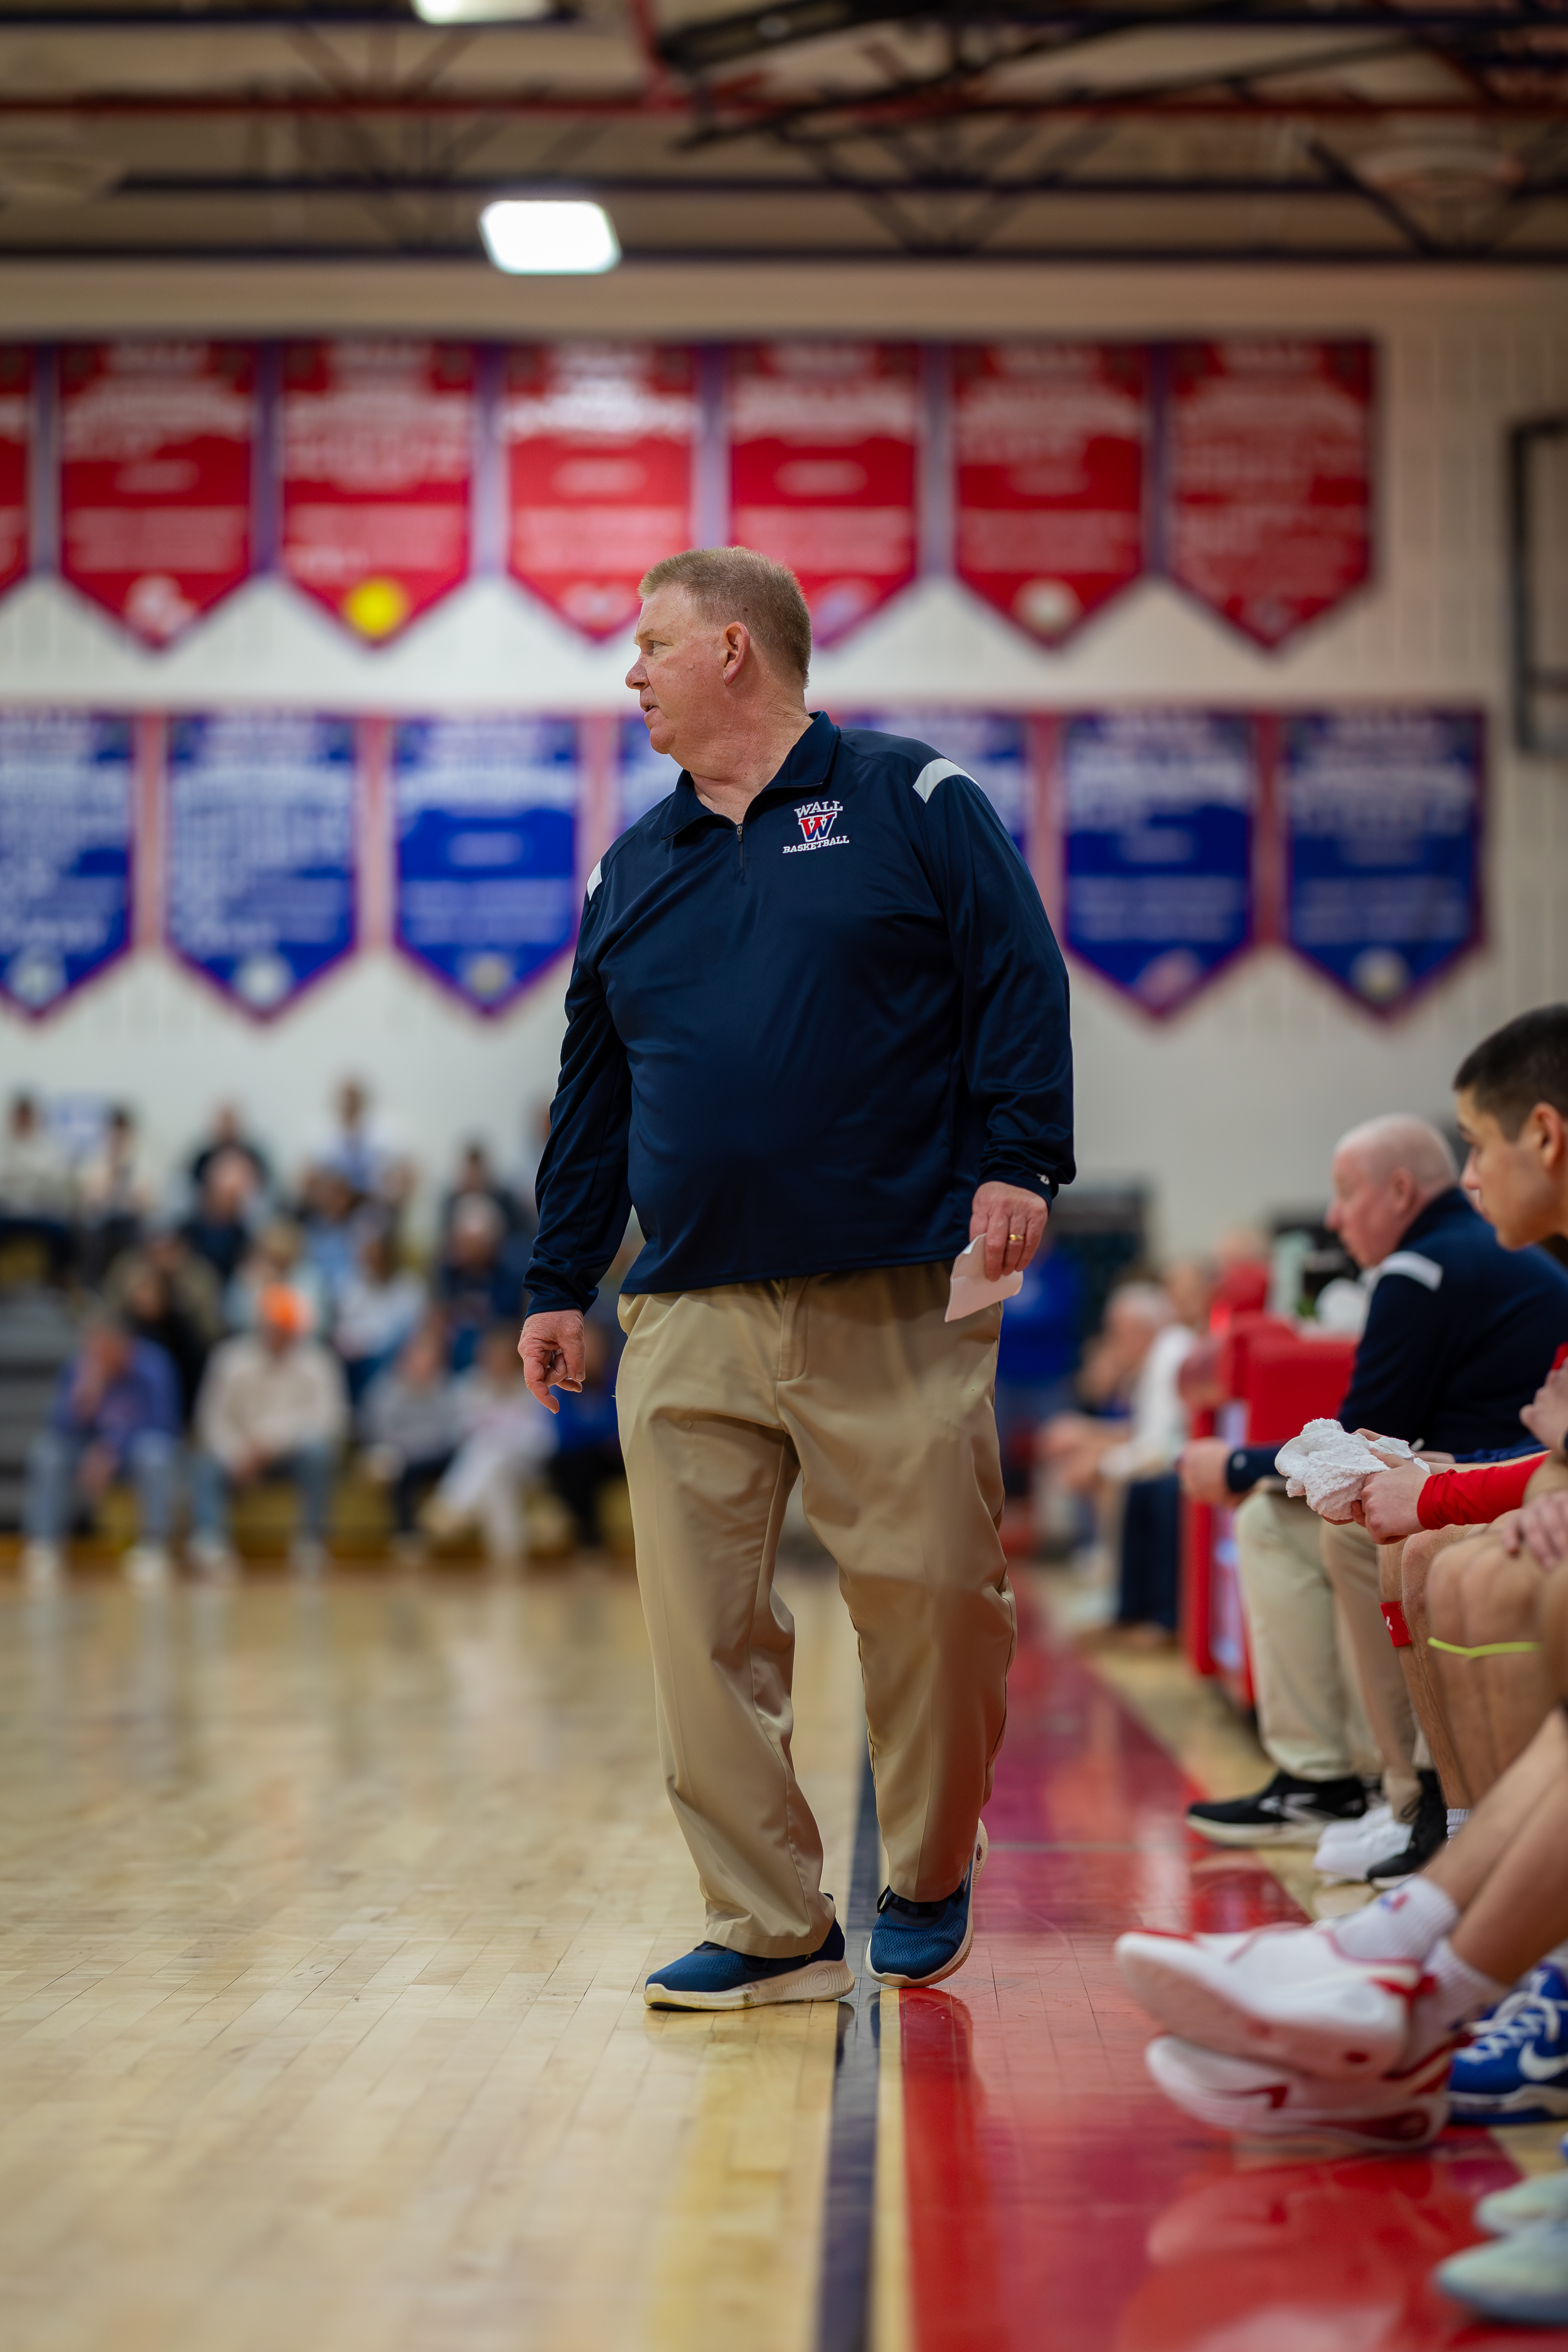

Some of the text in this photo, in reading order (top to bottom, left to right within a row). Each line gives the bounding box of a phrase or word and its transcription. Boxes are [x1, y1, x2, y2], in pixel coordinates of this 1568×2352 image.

[794, 801, 843, 818] WALL
[798, 811, 837, 842] W
[782, 835, 850, 853] BASKETBALL
